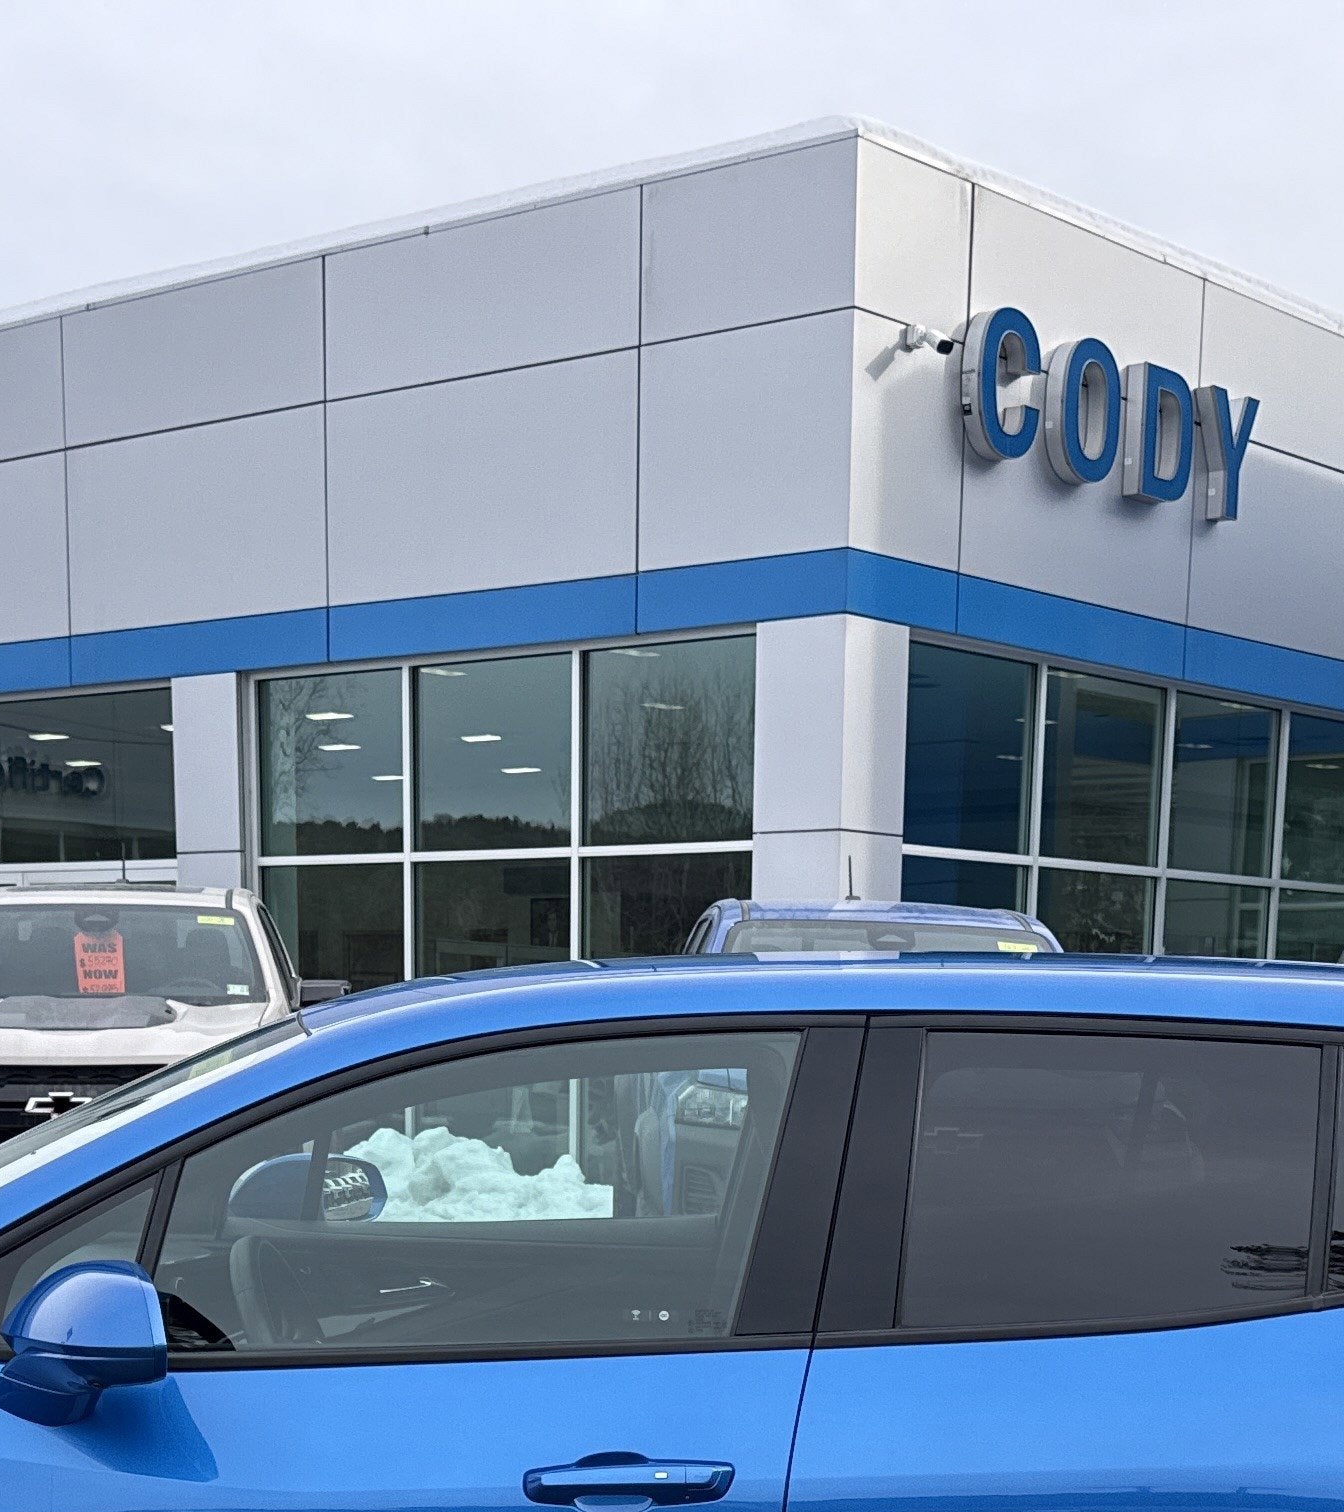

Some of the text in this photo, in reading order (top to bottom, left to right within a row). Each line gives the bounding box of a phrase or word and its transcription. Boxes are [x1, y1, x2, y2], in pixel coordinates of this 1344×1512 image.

[964, 307, 1260, 521] CODY
[82, 943, 117, 953] WAS
[82, 969, 118, 980] NOW
